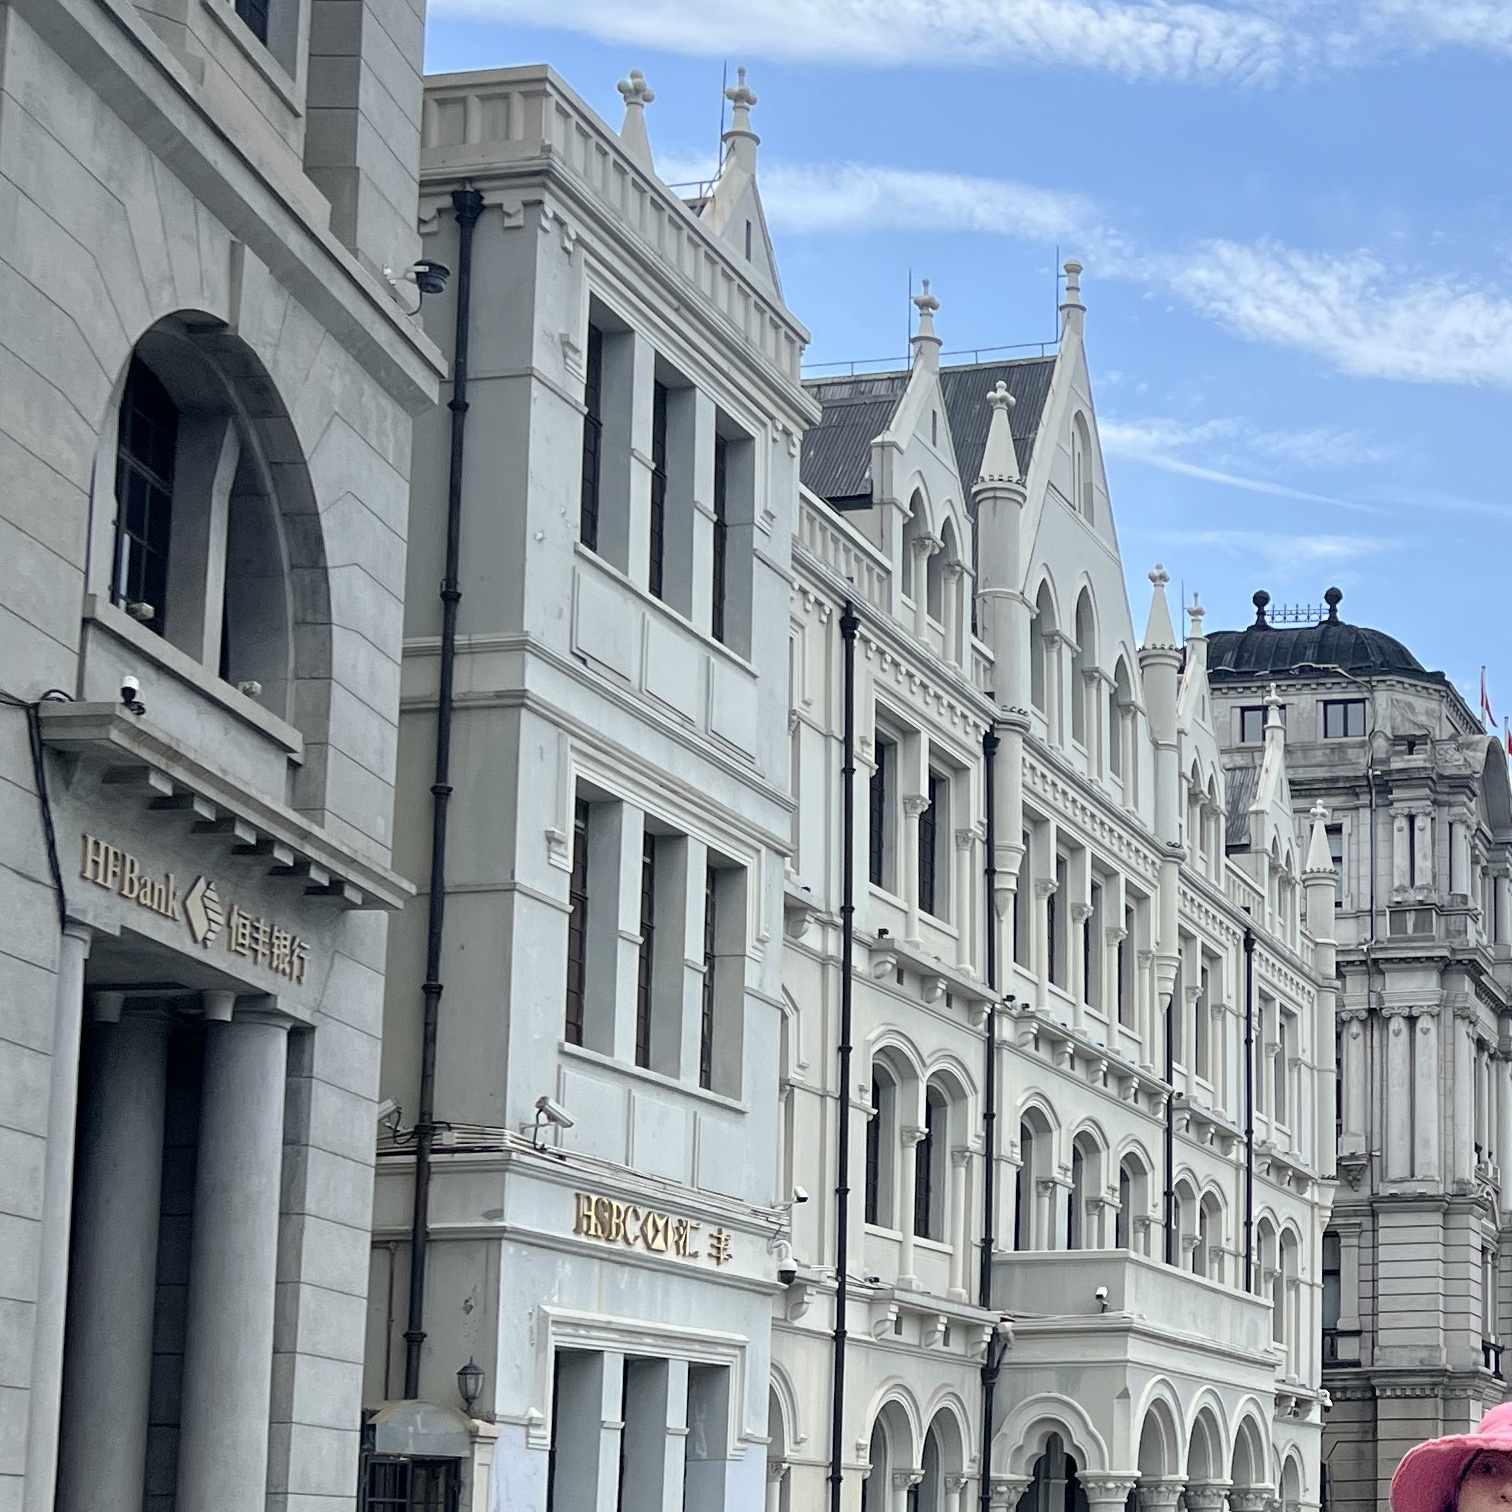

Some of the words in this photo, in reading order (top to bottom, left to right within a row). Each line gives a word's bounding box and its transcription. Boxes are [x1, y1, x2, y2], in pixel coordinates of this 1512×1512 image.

[228, 903, 312, 986] 恒丰银行
[572, 1192, 642, 1246] HSBC
[674, 1217, 733, 1266] 汇丰
